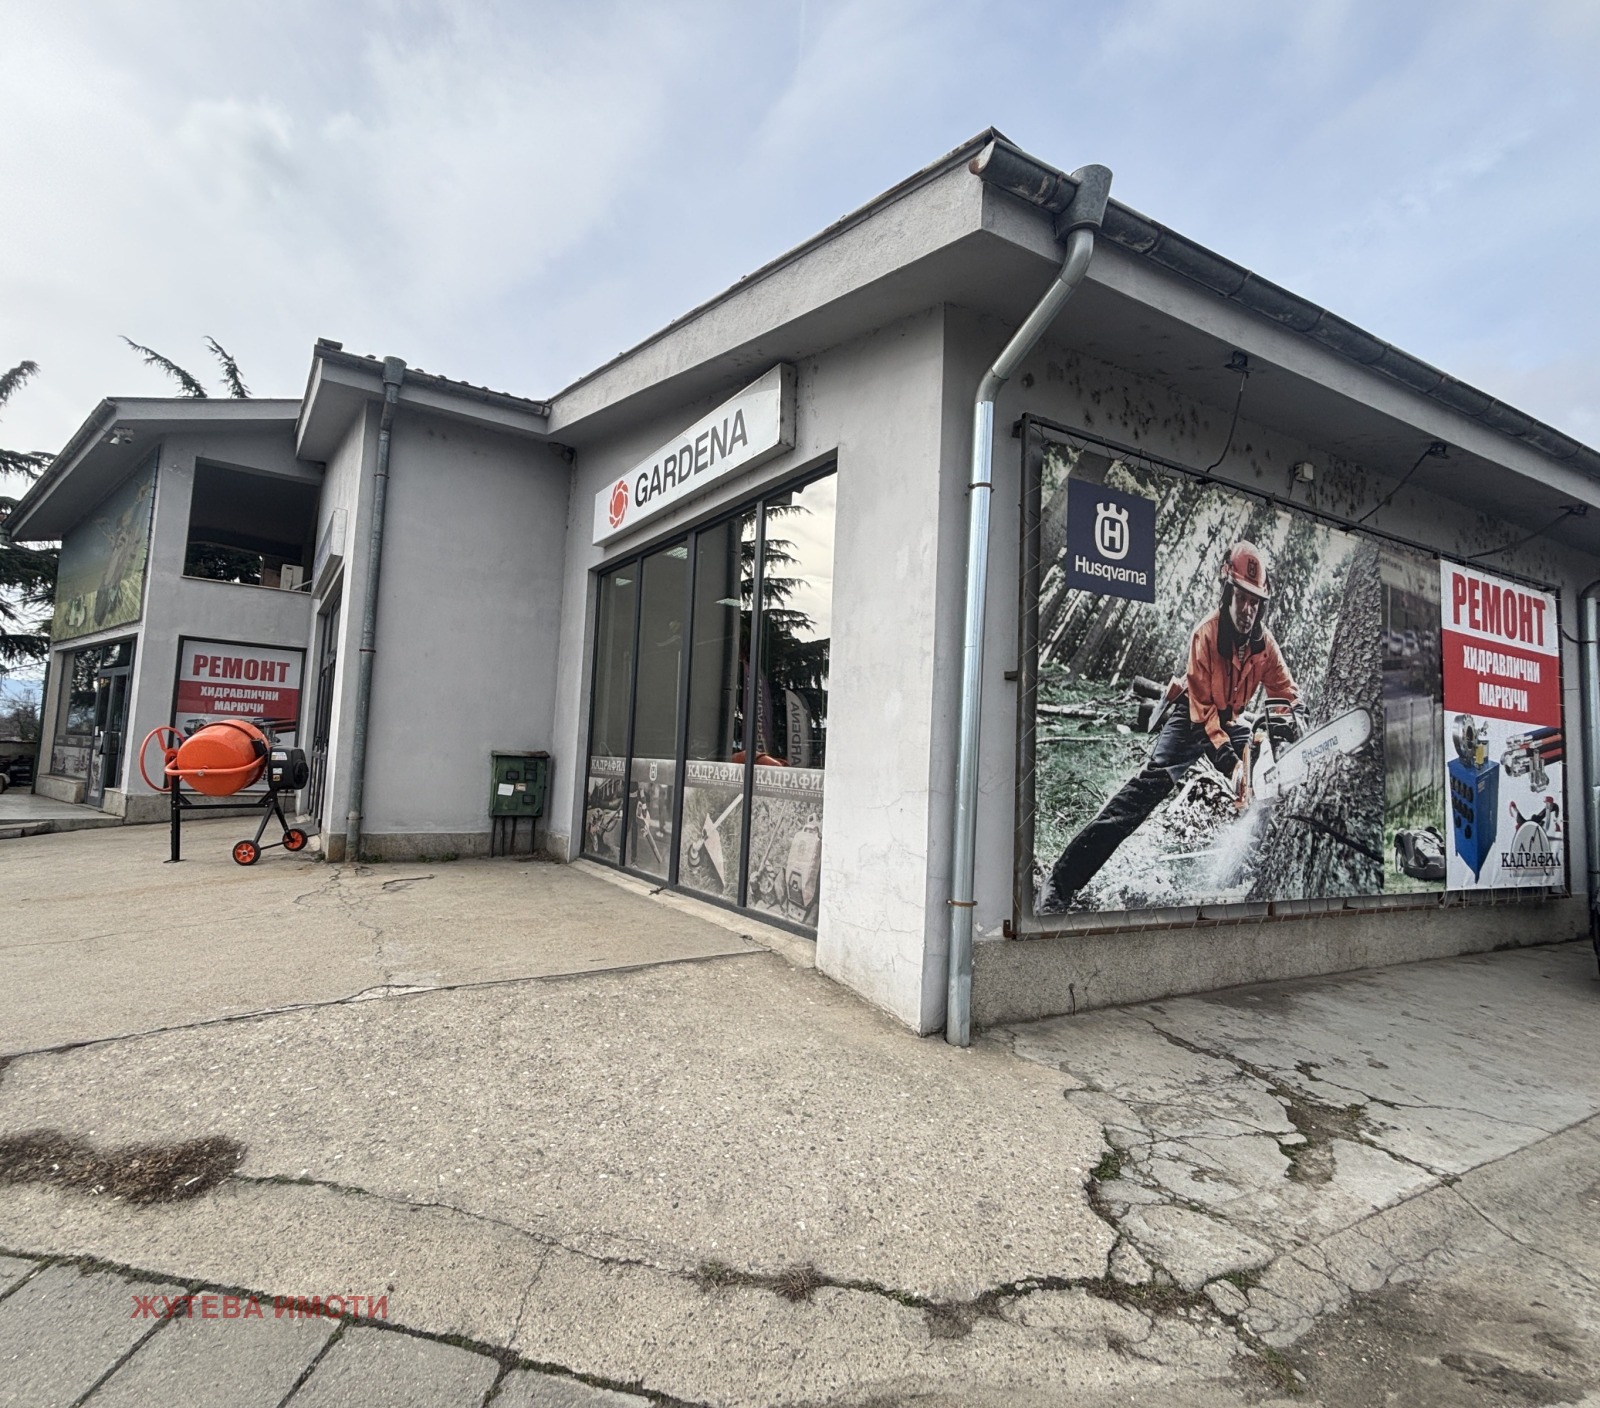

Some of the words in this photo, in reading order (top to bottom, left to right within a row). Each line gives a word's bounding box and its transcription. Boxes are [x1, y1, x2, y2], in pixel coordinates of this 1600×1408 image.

[634, 408, 748, 508] GARDENA
[1075, 555, 1147, 585] Husqvarna
[1452, 572, 1546, 646] РЕМОНТ
[193, 654, 290, 682] РЕМОНТ
[1463, 645, 1540, 683] ХИДРАВЛИЧНИ
[201, 686, 279, 701] ХИДРАВЛИЧНИ
[214, 700, 264, 713] МАРКУЧИ
[1478, 682, 1529, 712] МАРКУЧИ
[592, 760, 625, 772] КАДРАФИЛ
[687, 764, 744, 783] КАДРАФИЛ
[1501, 852, 1561, 869] КАДРАФИЛ
